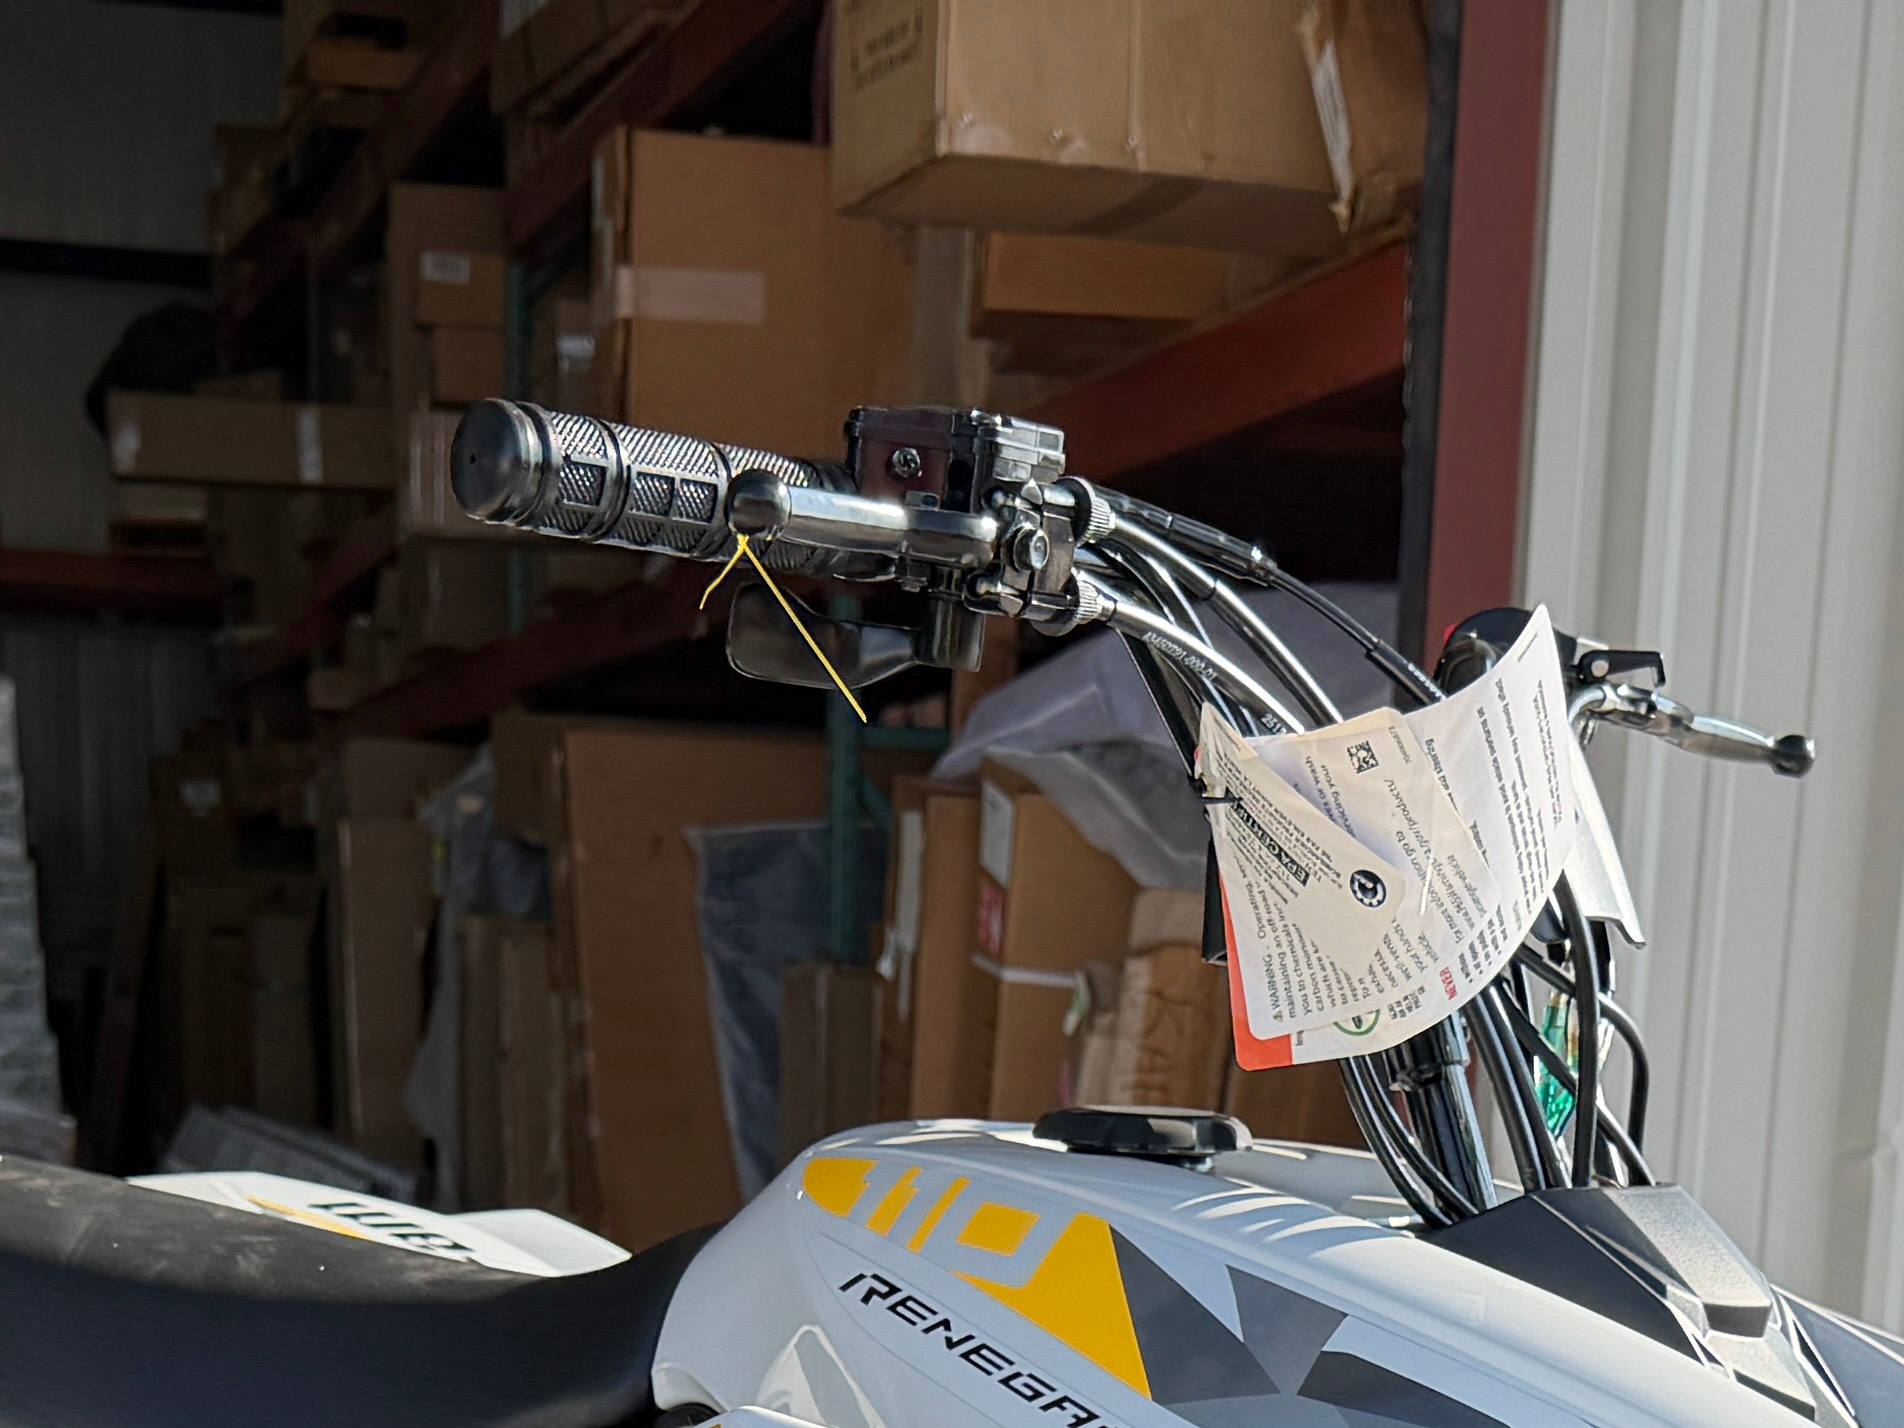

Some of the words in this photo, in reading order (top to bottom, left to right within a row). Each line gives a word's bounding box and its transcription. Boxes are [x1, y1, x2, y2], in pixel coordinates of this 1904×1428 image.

[1302, 755, 1323, 787] wash
[1318, 763, 1336, 789] your
[1393, 829, 1406, 843] to
[1398, 841, 1414, 858] go
[1277, 850, 1307, 881] EPA
[1272, 934, 1282, 949] an
[1279, 922, 1303, 977] chemicals
[1450, 928, 1465, 944] For
[1261, 953, 1280, 1009] WARNING
[1274, 951, 1298, 1018] maintaining
[1294, 978, 1306, 991] to
[1305, 971, 1324, 1011] carbon
[1319, 972, 1337, 1008] which
[1298, 993, 1312, 1015] you
